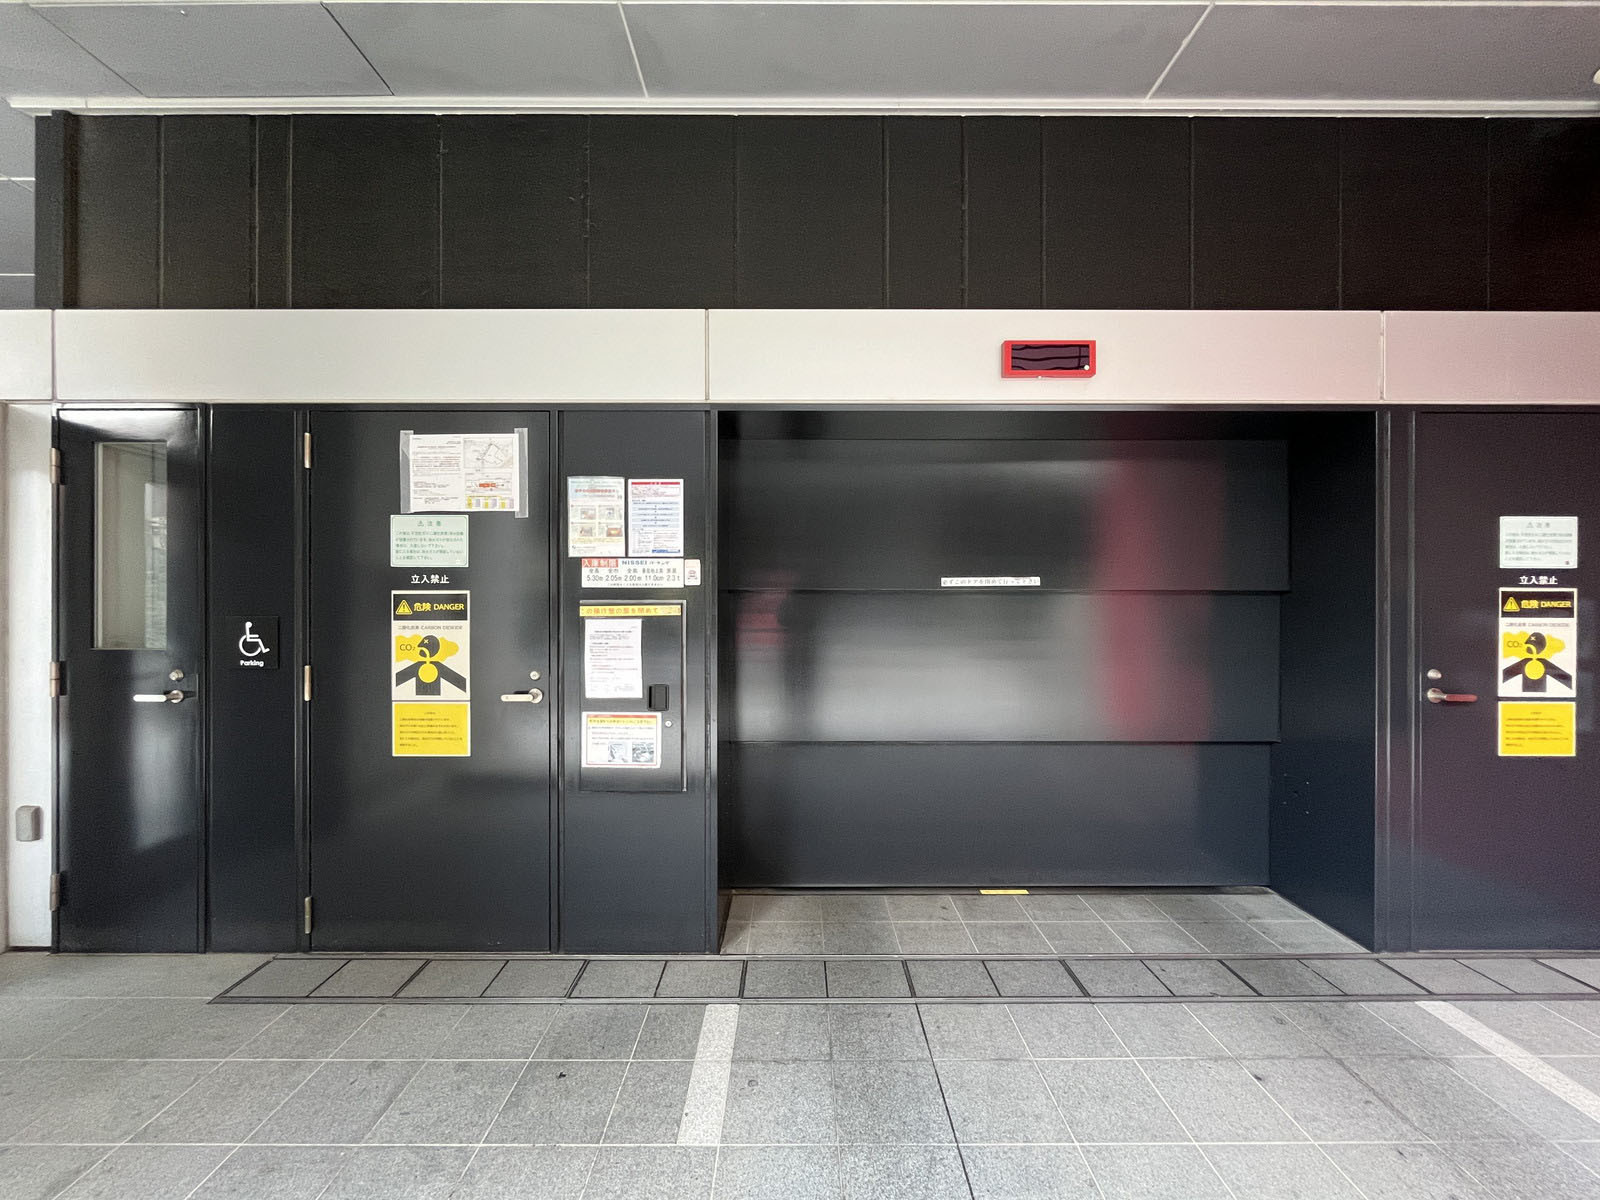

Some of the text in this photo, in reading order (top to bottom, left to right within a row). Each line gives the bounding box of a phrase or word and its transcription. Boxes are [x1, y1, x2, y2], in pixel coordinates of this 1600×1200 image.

[411, 574, 450, 584] 立入禁止
[586, 574, 603, 582] 5.30m
[605, 574, 622, 582] 2.05m
[624, 574, 642, 582] 2.00m
[1518, 575, 1558, 585] 立入禁止
[413, 602, 465, 612] 危険 DANGER
[1540, 600, 1572, 608] DANGER
